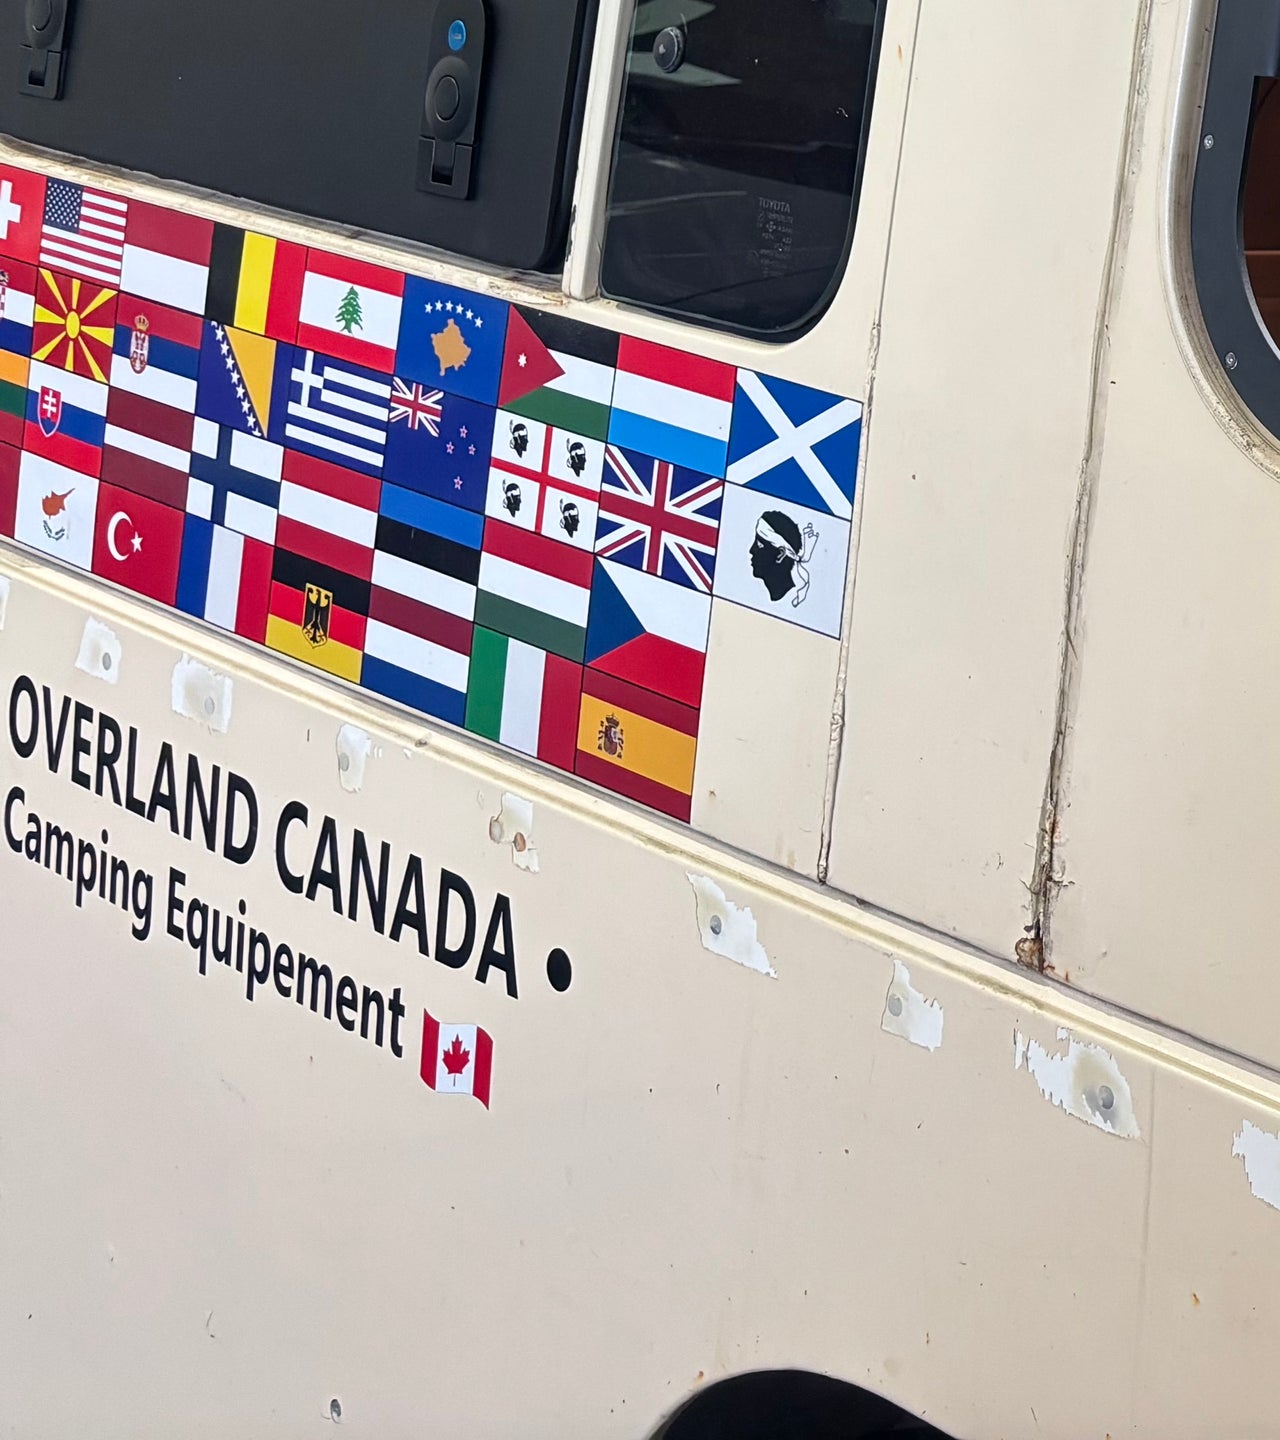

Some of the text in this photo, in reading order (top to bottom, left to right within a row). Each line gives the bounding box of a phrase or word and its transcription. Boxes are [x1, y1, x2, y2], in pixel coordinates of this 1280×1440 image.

[758, 197, 791, 213] TOYOTA
[4, 786, 405, 1058] Camping Equipement
[9, 675, 518, 1000] OVERLAND CANADA
